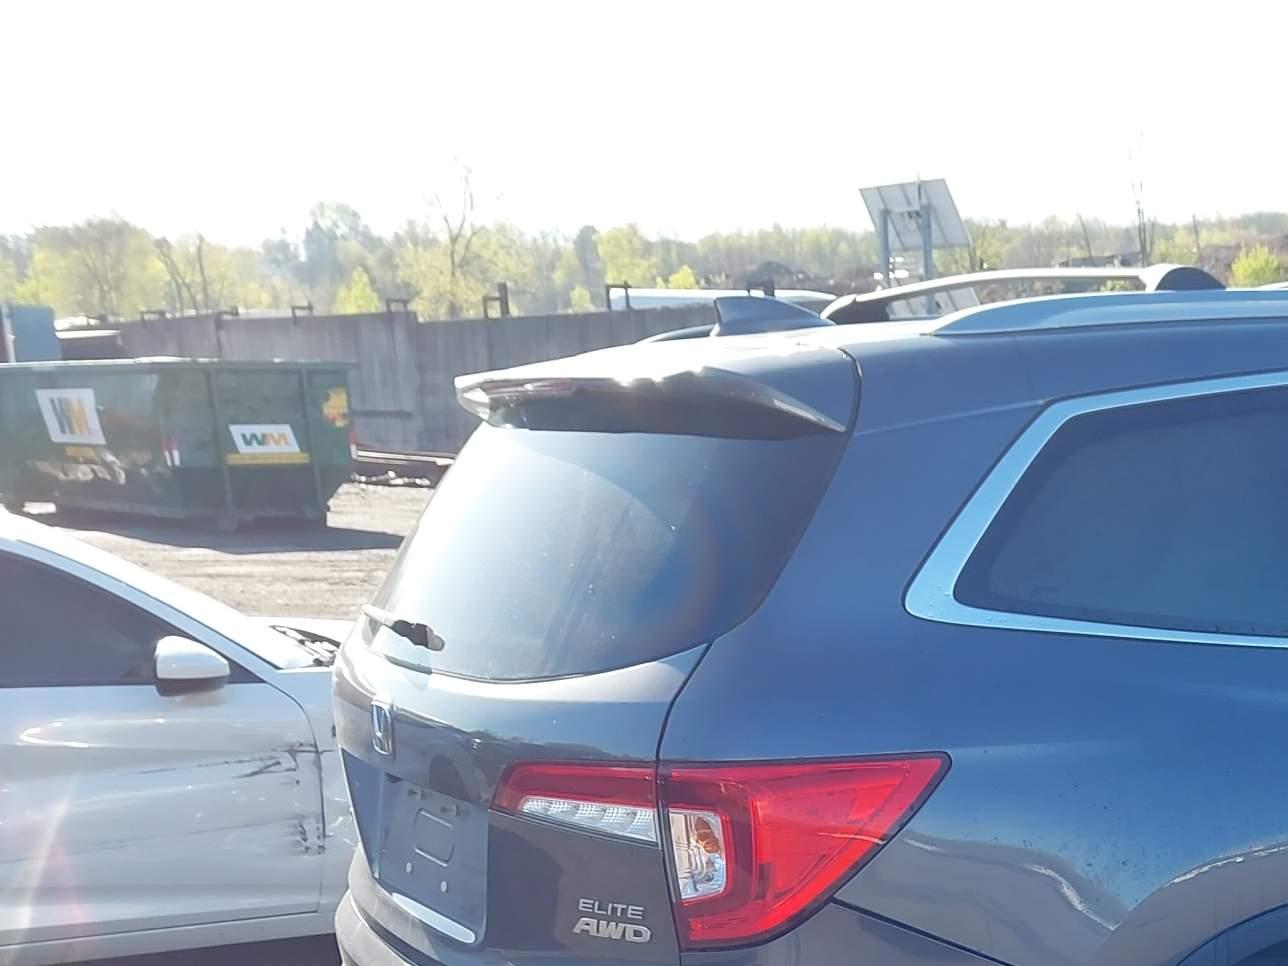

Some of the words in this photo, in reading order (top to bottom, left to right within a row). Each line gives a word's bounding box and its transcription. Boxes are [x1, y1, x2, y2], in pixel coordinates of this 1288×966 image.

[240, 432, 290, 447] WM
[577, 898, 645, 920] ELITE
[572, 917, 652, 943] AWD
